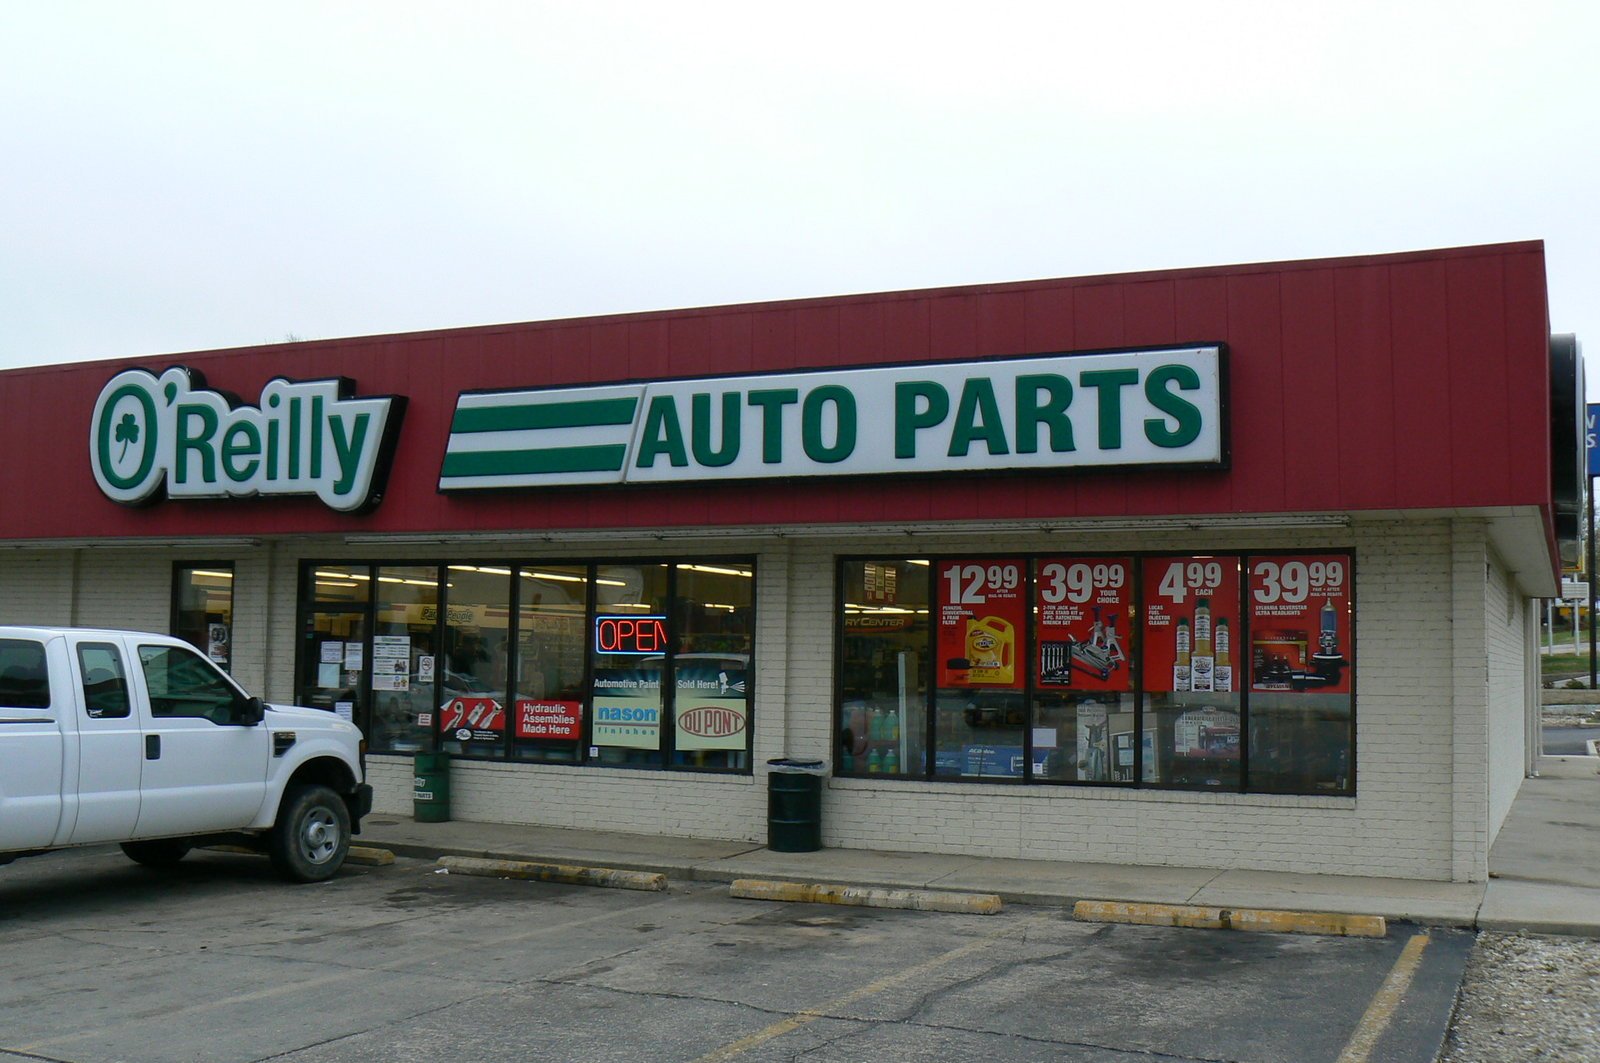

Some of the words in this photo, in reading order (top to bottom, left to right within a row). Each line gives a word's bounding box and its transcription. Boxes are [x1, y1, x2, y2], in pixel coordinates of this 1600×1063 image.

[636, 384, 857, 468] AUTO
[895, 364, 1203, 459] PARTS
[97, 382, 371, 495] O'Reilly
[1195, 588, 1213, 596] EACH
[594, 678, 637, 689] Automotive
[639, 680, 660, 689] Paint
[677, 679, 696, 689] Sold
[697, 679, 719, 689] Here!
[523, 703, 566, 714] Hydraulic
[523, 713, 575, 725] Assemblies
[598, 707, 657, 722] nason
[523, 724, 547, 733] Made
[548, 724, 570, 735] Here
[598, 727, 656, 736] finishes
